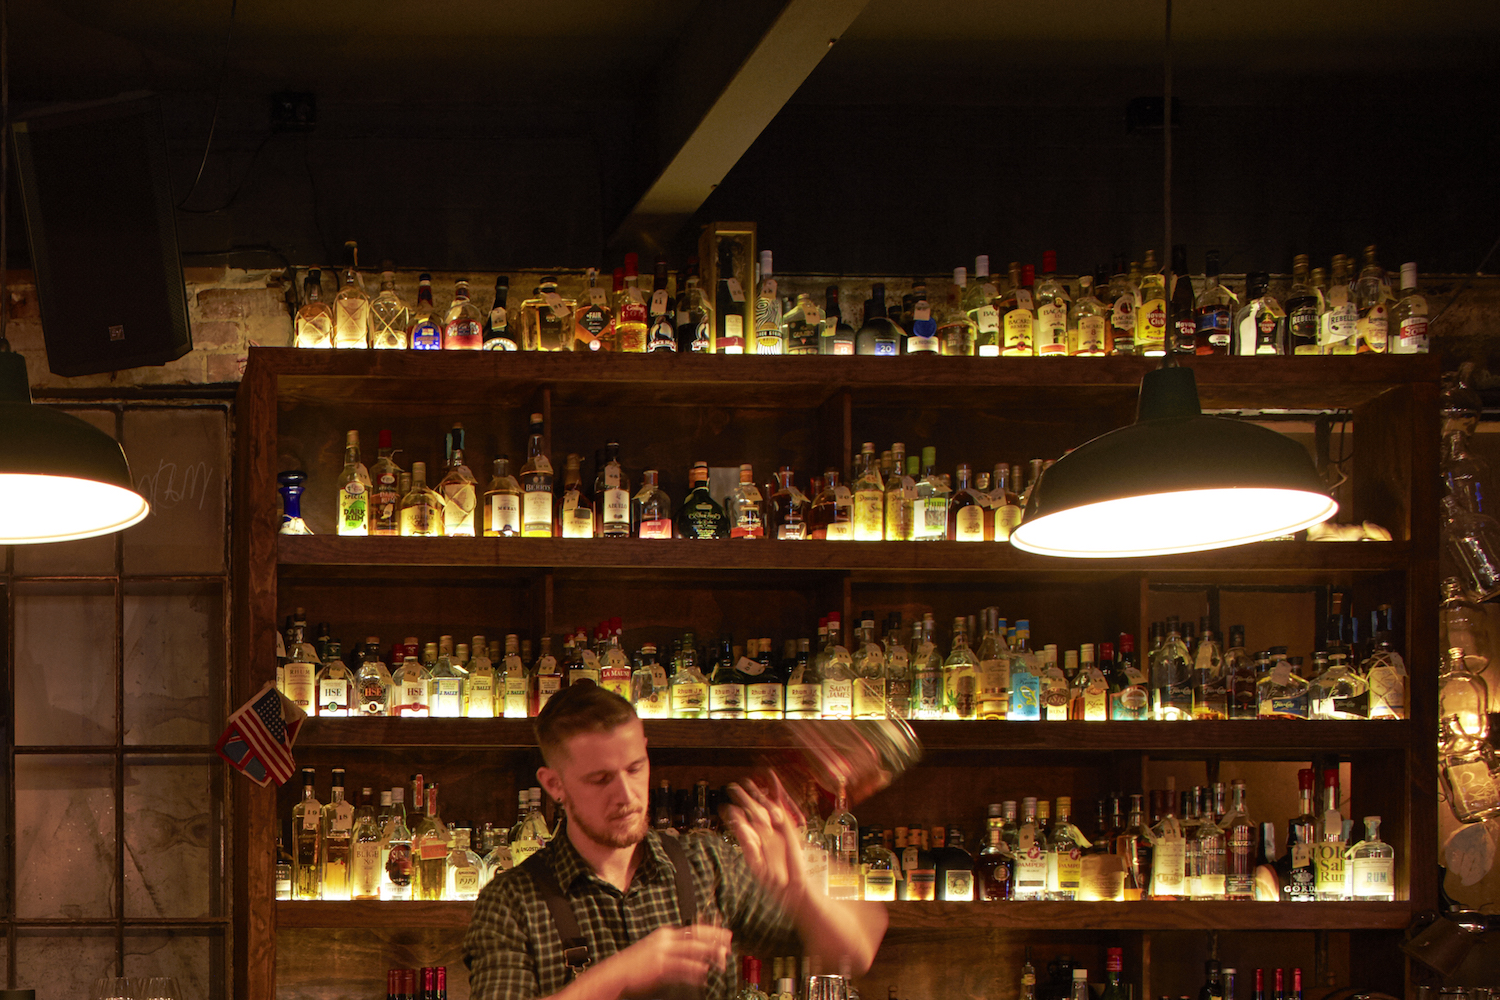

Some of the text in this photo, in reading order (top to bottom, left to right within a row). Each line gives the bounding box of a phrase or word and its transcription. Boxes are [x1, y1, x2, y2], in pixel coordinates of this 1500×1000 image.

[325, 688, 342, 697] HSE
[364, 687, 382, 696] HSE
[407, 688, 424, 696] HSE
[459, 877, 476, 885] 1919
[1367, 872, 1387, 882] RUM
